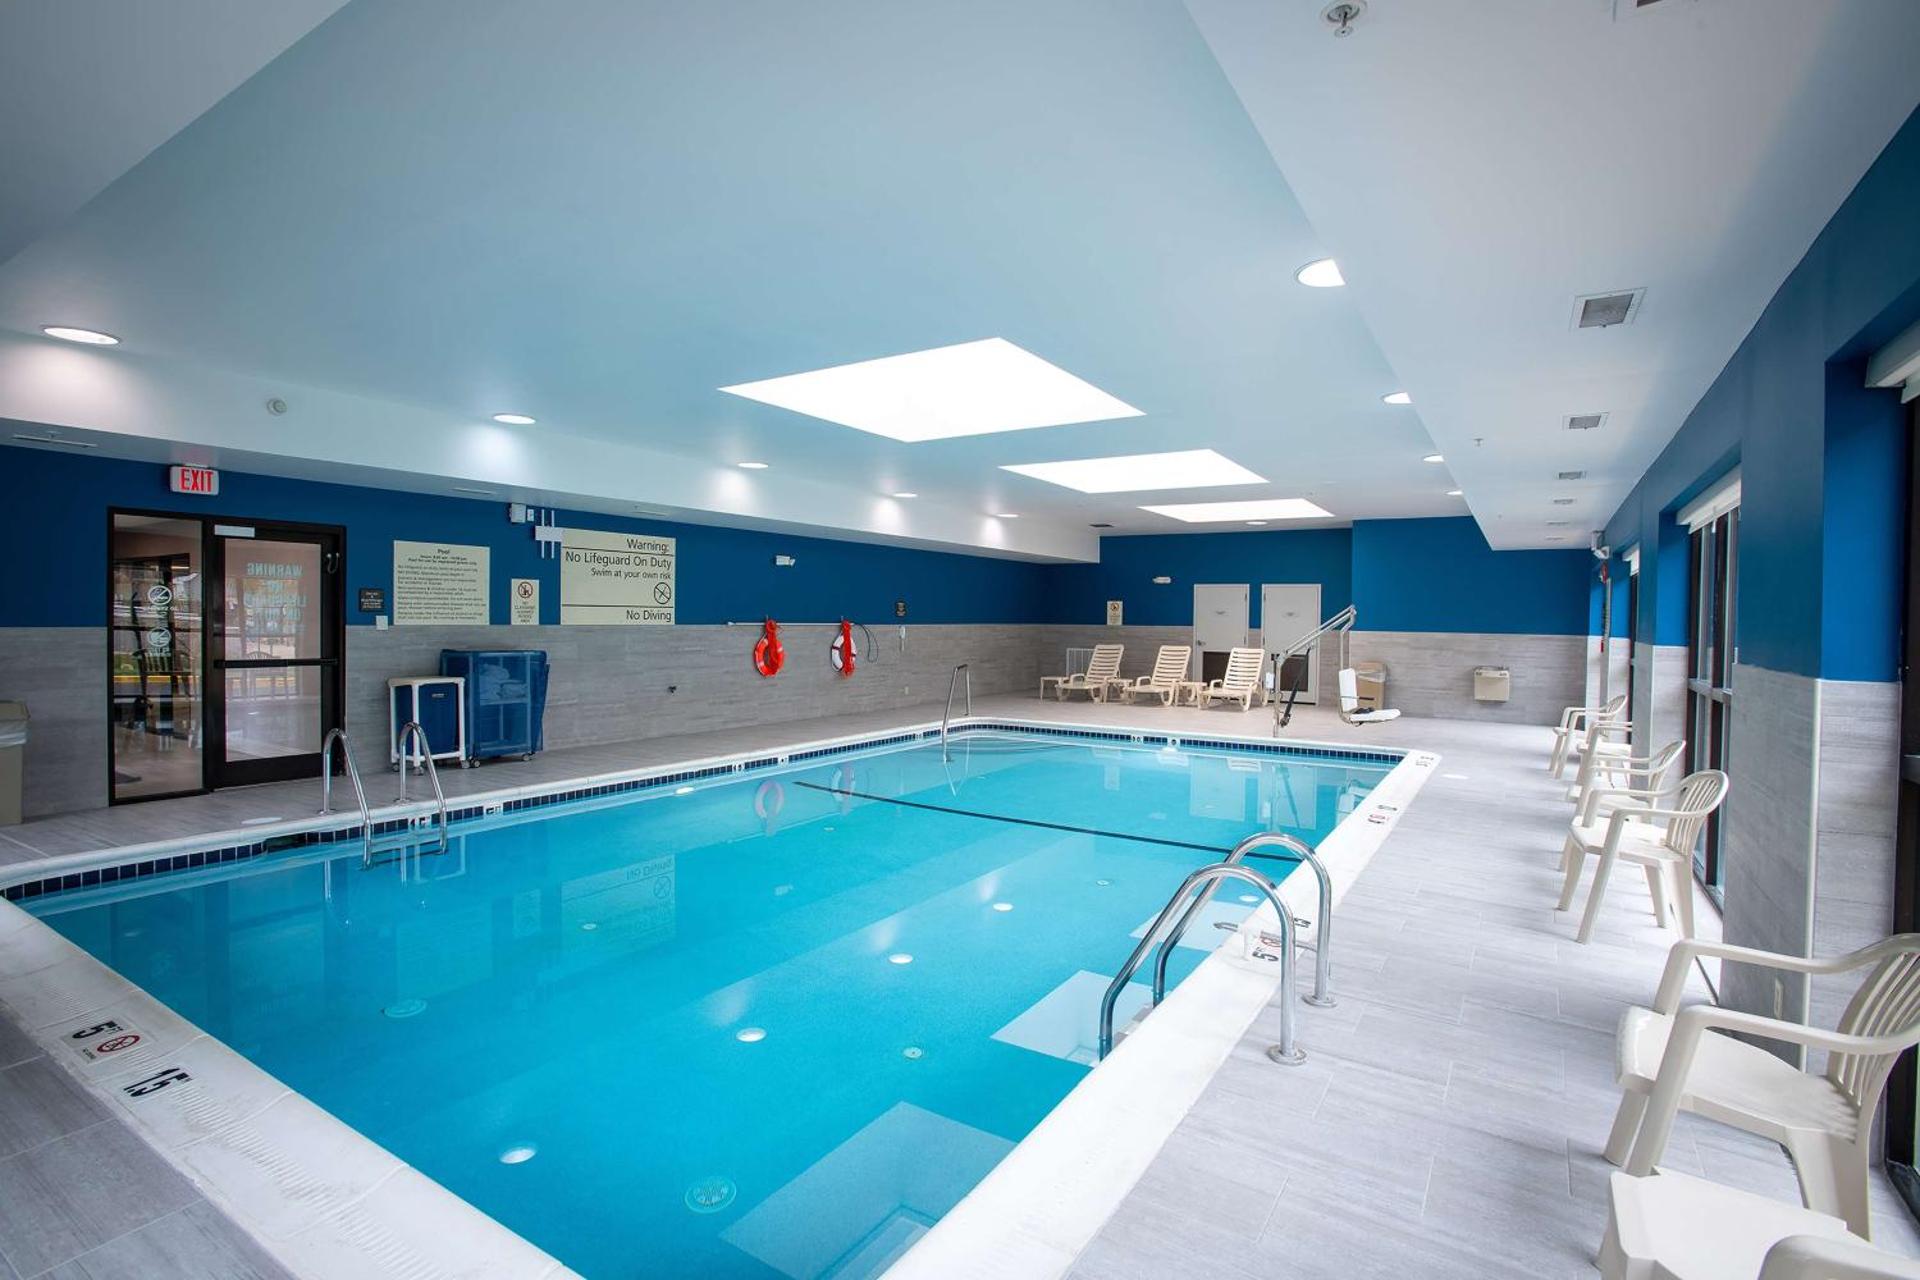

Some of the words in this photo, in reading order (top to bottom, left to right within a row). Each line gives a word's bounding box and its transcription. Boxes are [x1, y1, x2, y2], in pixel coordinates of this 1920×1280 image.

[181, 468, 214, 492] EXIT
[627, 538, 669, 554] Warning:
[565, 551, 581, 562] No
[584, 553, 631, 567] Lifeguard
[633, 556, 648, 566] On
[650, 557, 672, 570] Duty
[591, 567, 612, 577] Swim
[624, 571, 640, 579] your
[660, 571, 671, 579] risk
[626, 610, 640, 620] No
[643, 610, 672, 622] Diving
[72, 1020, 117, 1039] 5
